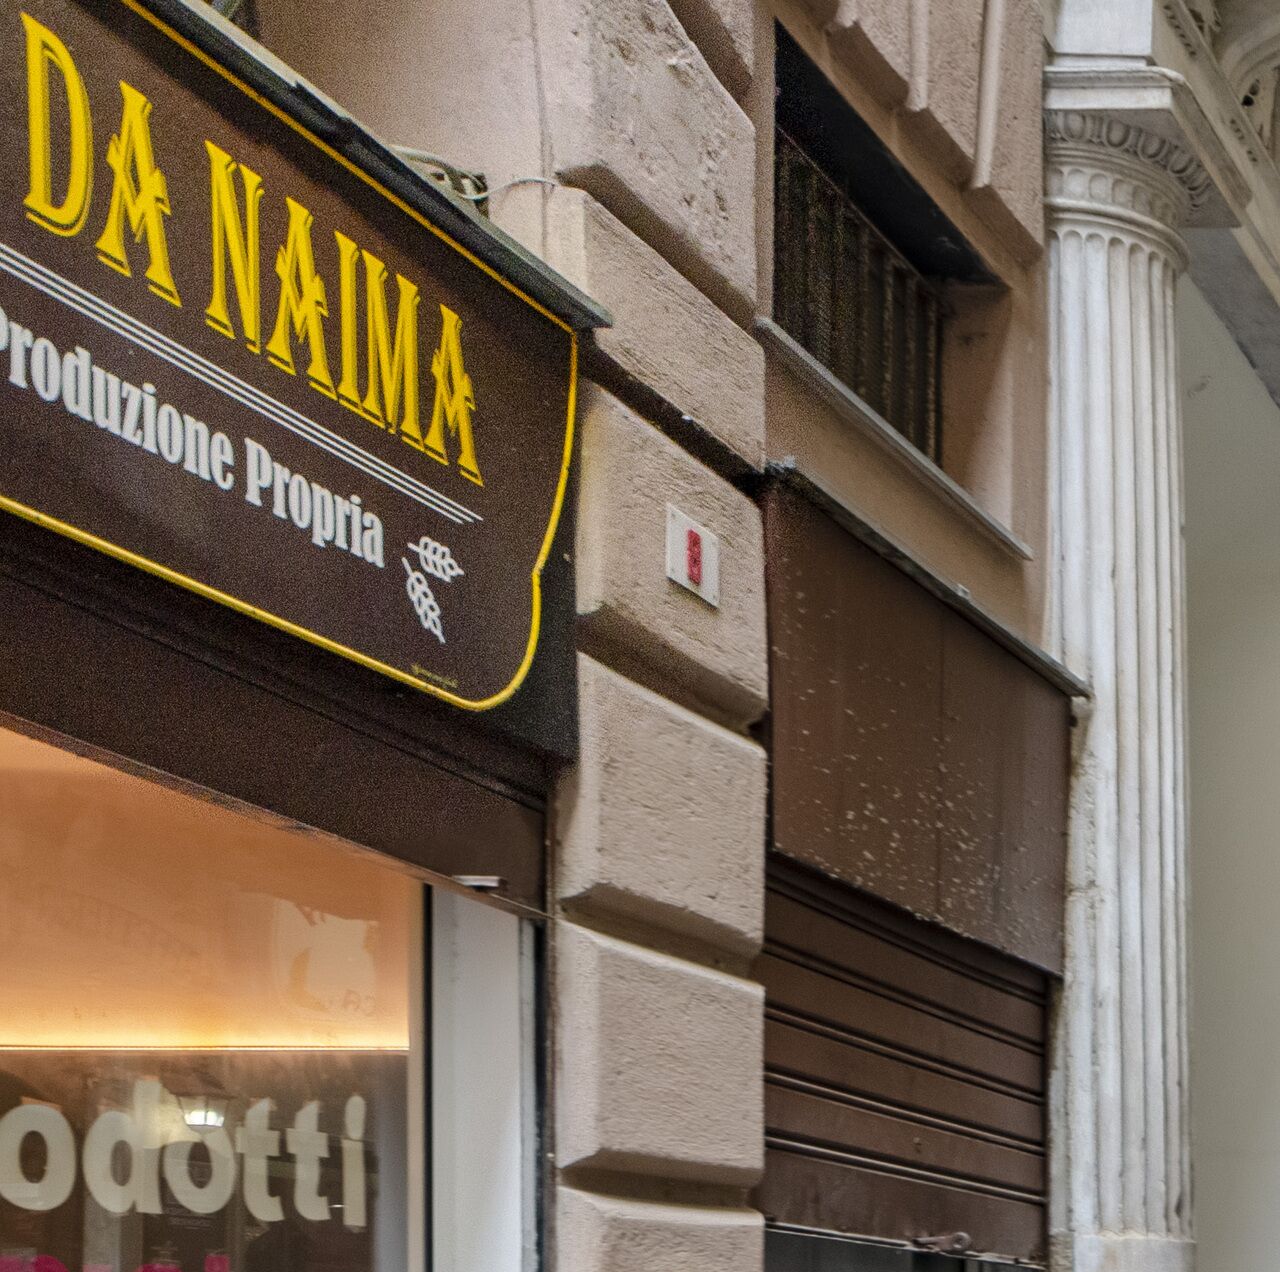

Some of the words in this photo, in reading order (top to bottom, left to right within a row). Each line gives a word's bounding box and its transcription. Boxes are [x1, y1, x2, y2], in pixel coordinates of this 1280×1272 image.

[21, 12, 182, 307] DA
[204, 139, 484, 486] NAIMA
[0, 306, 235, 490] roduzione
[244, 437, 385, 568] Propria
